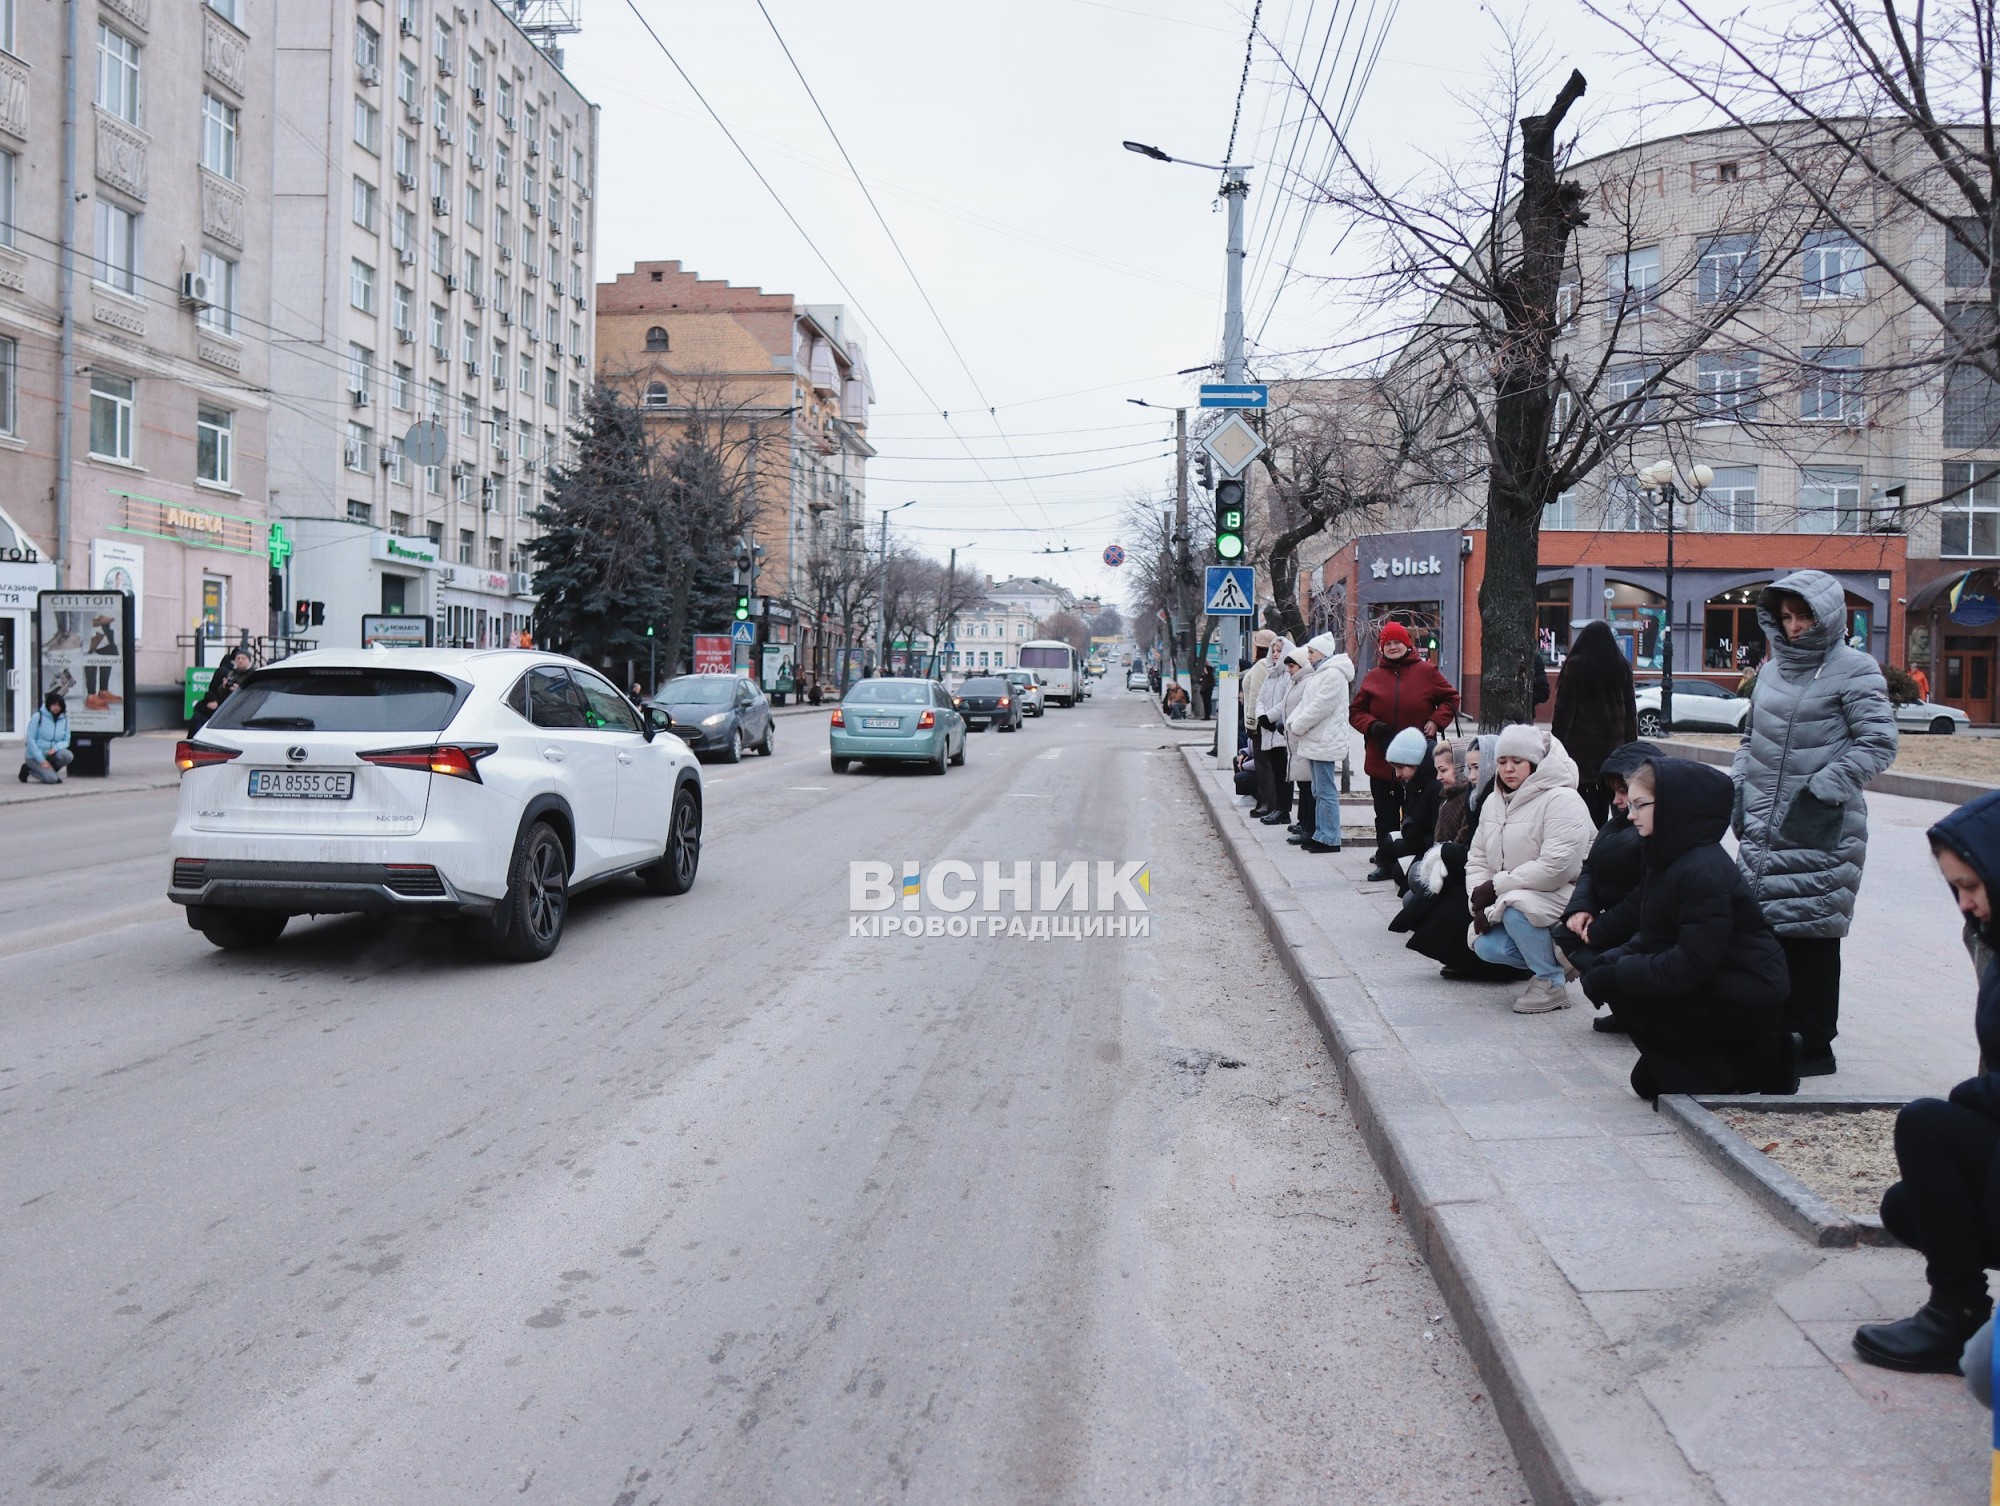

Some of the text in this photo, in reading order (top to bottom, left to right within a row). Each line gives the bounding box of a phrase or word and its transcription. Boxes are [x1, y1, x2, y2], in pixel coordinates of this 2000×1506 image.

[167, 508, 224, 534] АПТЕКА
[1227, 512, 1240, 527] 13
[1391, 555, 1441, 576] blisk
[84, 596, 113, 605] ТОП
[699, 663, 730, 675] 70%
[260, 775, 346, 792] BA 8555 CE
